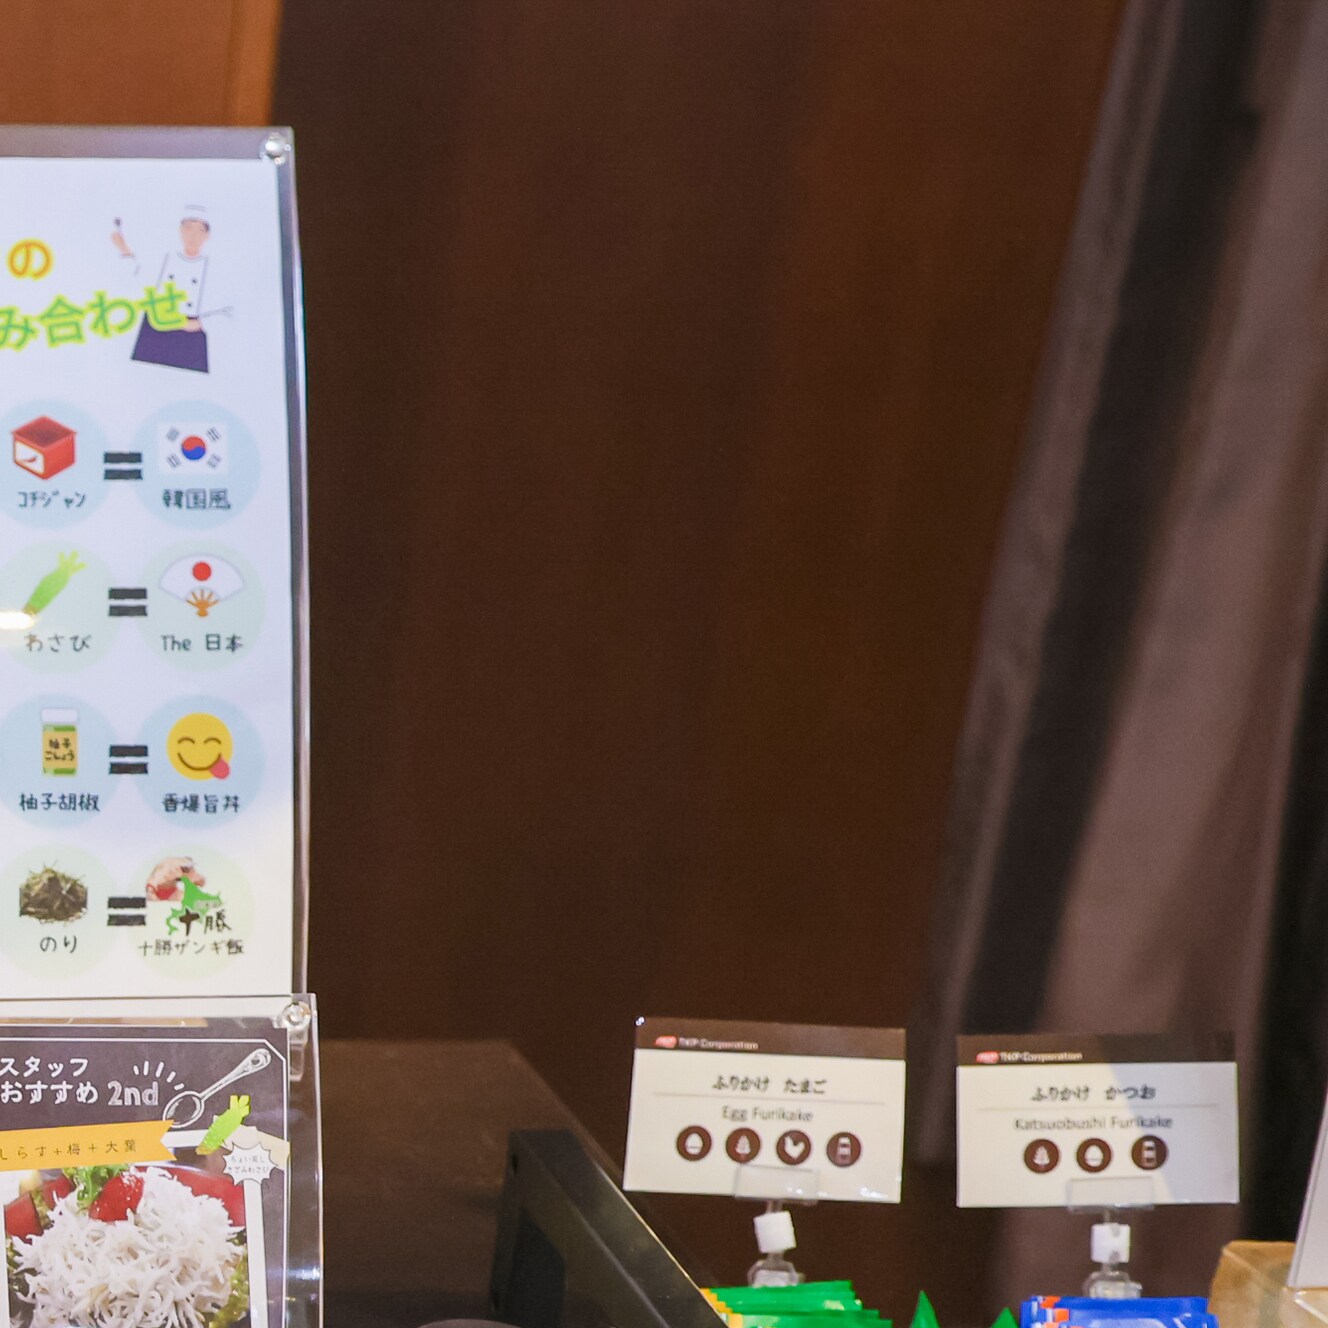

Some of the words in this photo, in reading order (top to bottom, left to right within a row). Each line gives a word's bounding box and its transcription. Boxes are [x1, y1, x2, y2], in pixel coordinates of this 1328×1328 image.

[163, 490, 230, 509] 韓国風
[27, 635, 91, 652] わさび
[162, 636, 191, 651] The
[206, 634, 241, 652] 日本
[20, 794, 99, 811] 柚子胡椒
[40, 936, 77, 953] のり
[1, 1081, 98, 1104] おすすめ
[108, 1081, 158, 1105] 2nd
[712, 1075, 770, 1091] ふりかけ
[785, 1078, 827, 1094] たまご
[1031, 1085, 1090, 1101] ふりかけ
[1105, 1084, 1156, 1100] かつお
[722, 1105, 748, 1121] Egg
[752, 1106, 813, 1121] Furikake
[1015, 1119, 1106, 1130] Katsuobushi
[1111, 1117, 1173, 1129] Furikake
